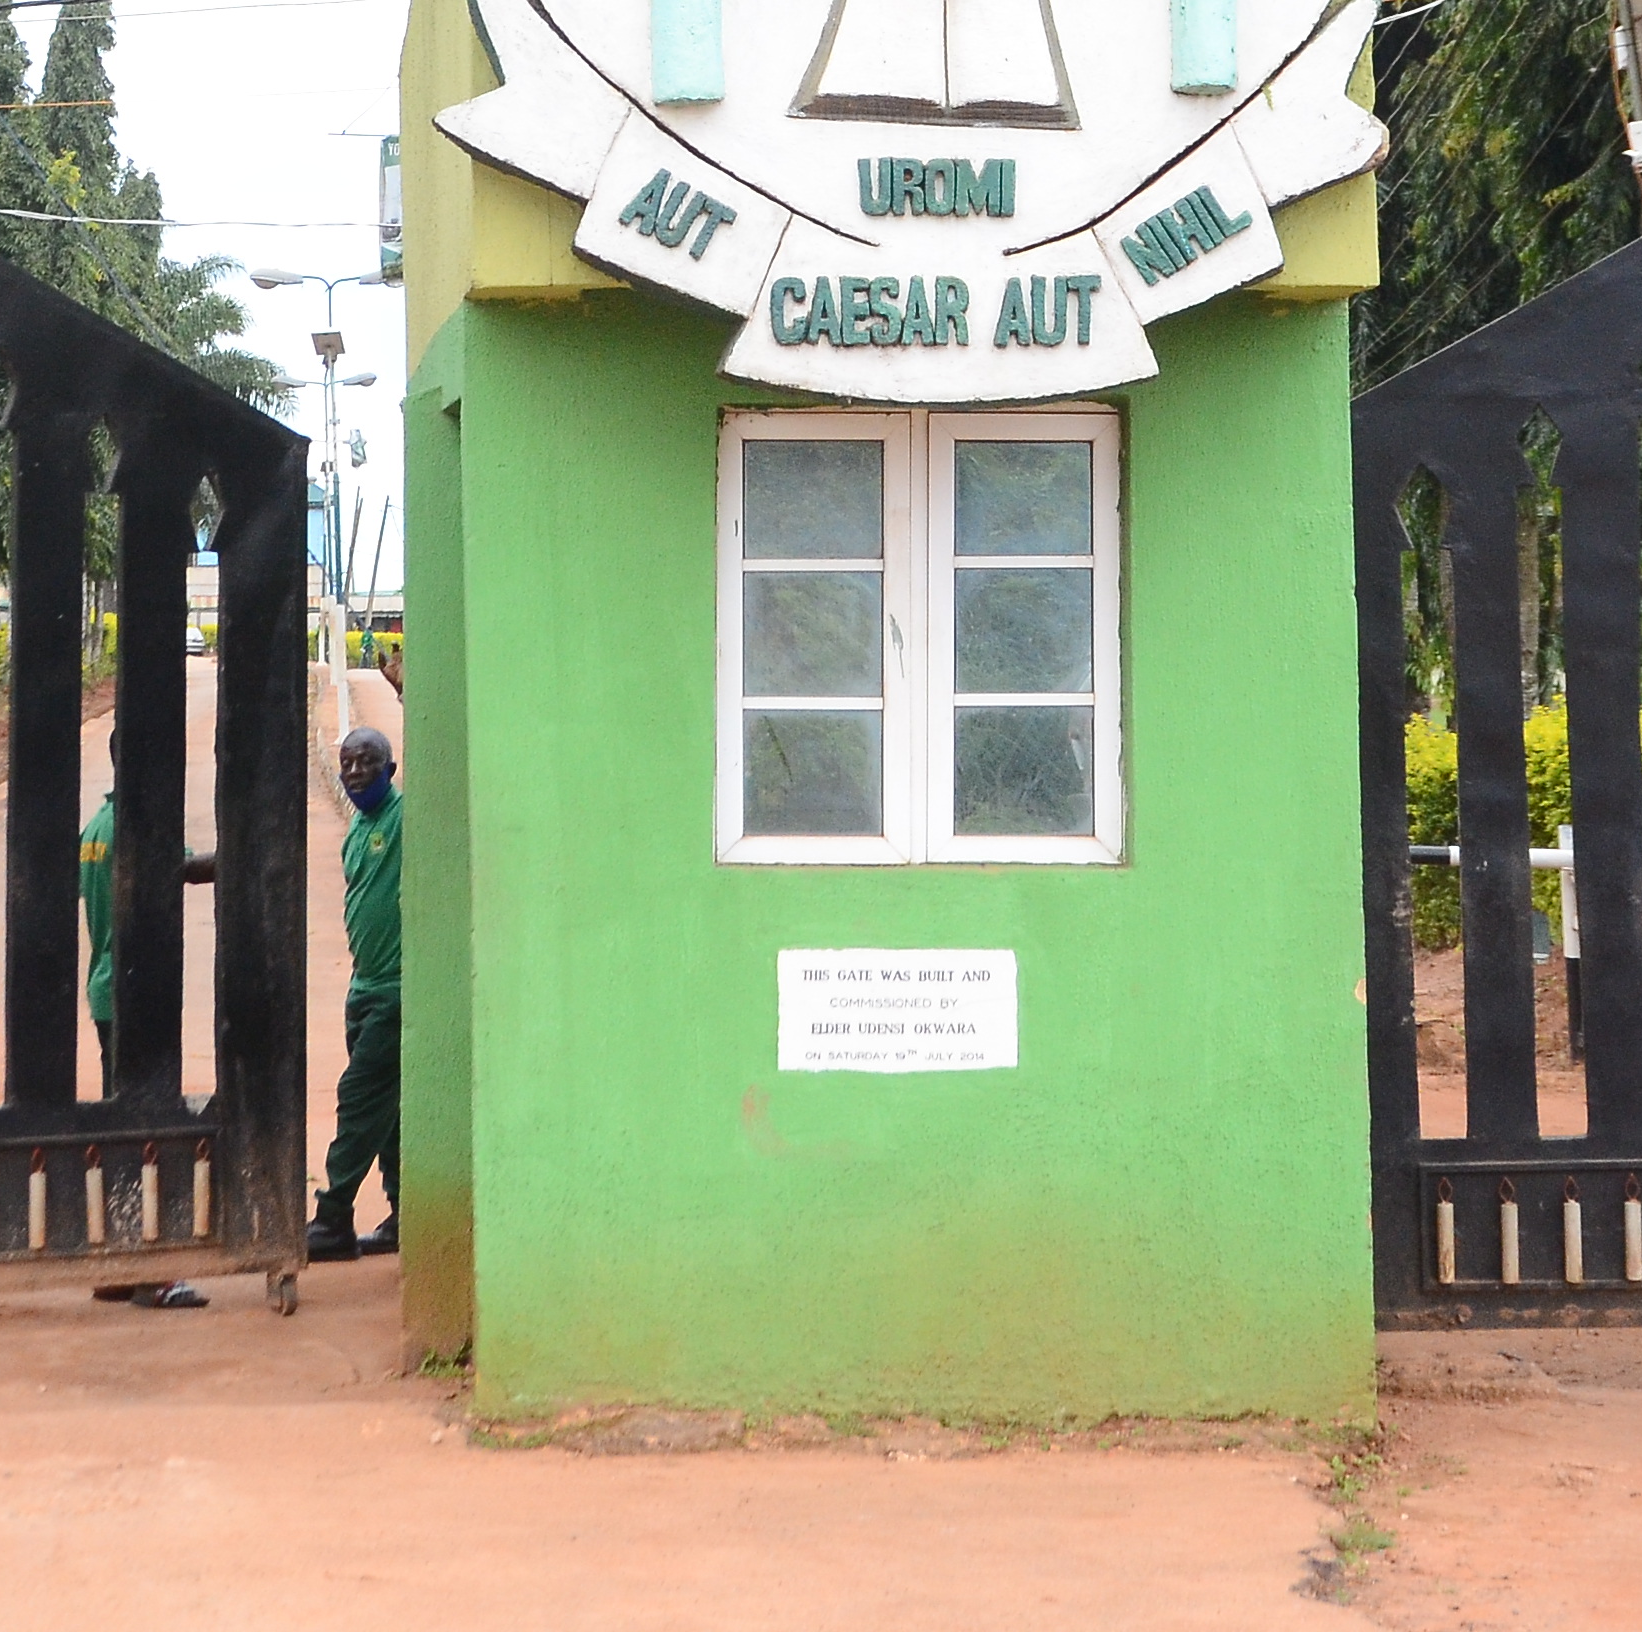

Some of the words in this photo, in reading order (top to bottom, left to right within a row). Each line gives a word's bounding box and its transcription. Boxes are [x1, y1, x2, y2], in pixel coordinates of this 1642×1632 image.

[857, 158, 1016, 220] UROMI
[619, 169, 736, 261] AUT
[769, 275, 969, 347] CAESAR
[994, 274, 1101, 347] AUT
[1121, 185, 1252, 286] NIHIL
[802, 970, 830, 982] THIS
[837, 970, 873, 982] GATE
[881, 970, 911, 982] WAS
[918, 970, 954, 982] BUILT
[962, 970, 991, 982] AND
[829, 997, 932, 1009] COMMISSIONED
[940, 997, 959, 1009] BY
[811, 1023, 851, 1035] ELDER
[858, 1023, 905, 1035] UDENSI
[914, 1023, 976, 1035] OKWARA
[805, 1051, 821, 1061] ON
[828, 1051, 888, 1061] SATURDAY
[925, 1051, 953, 1061] JULY
[960, 1051, 985, 1061] 2014
